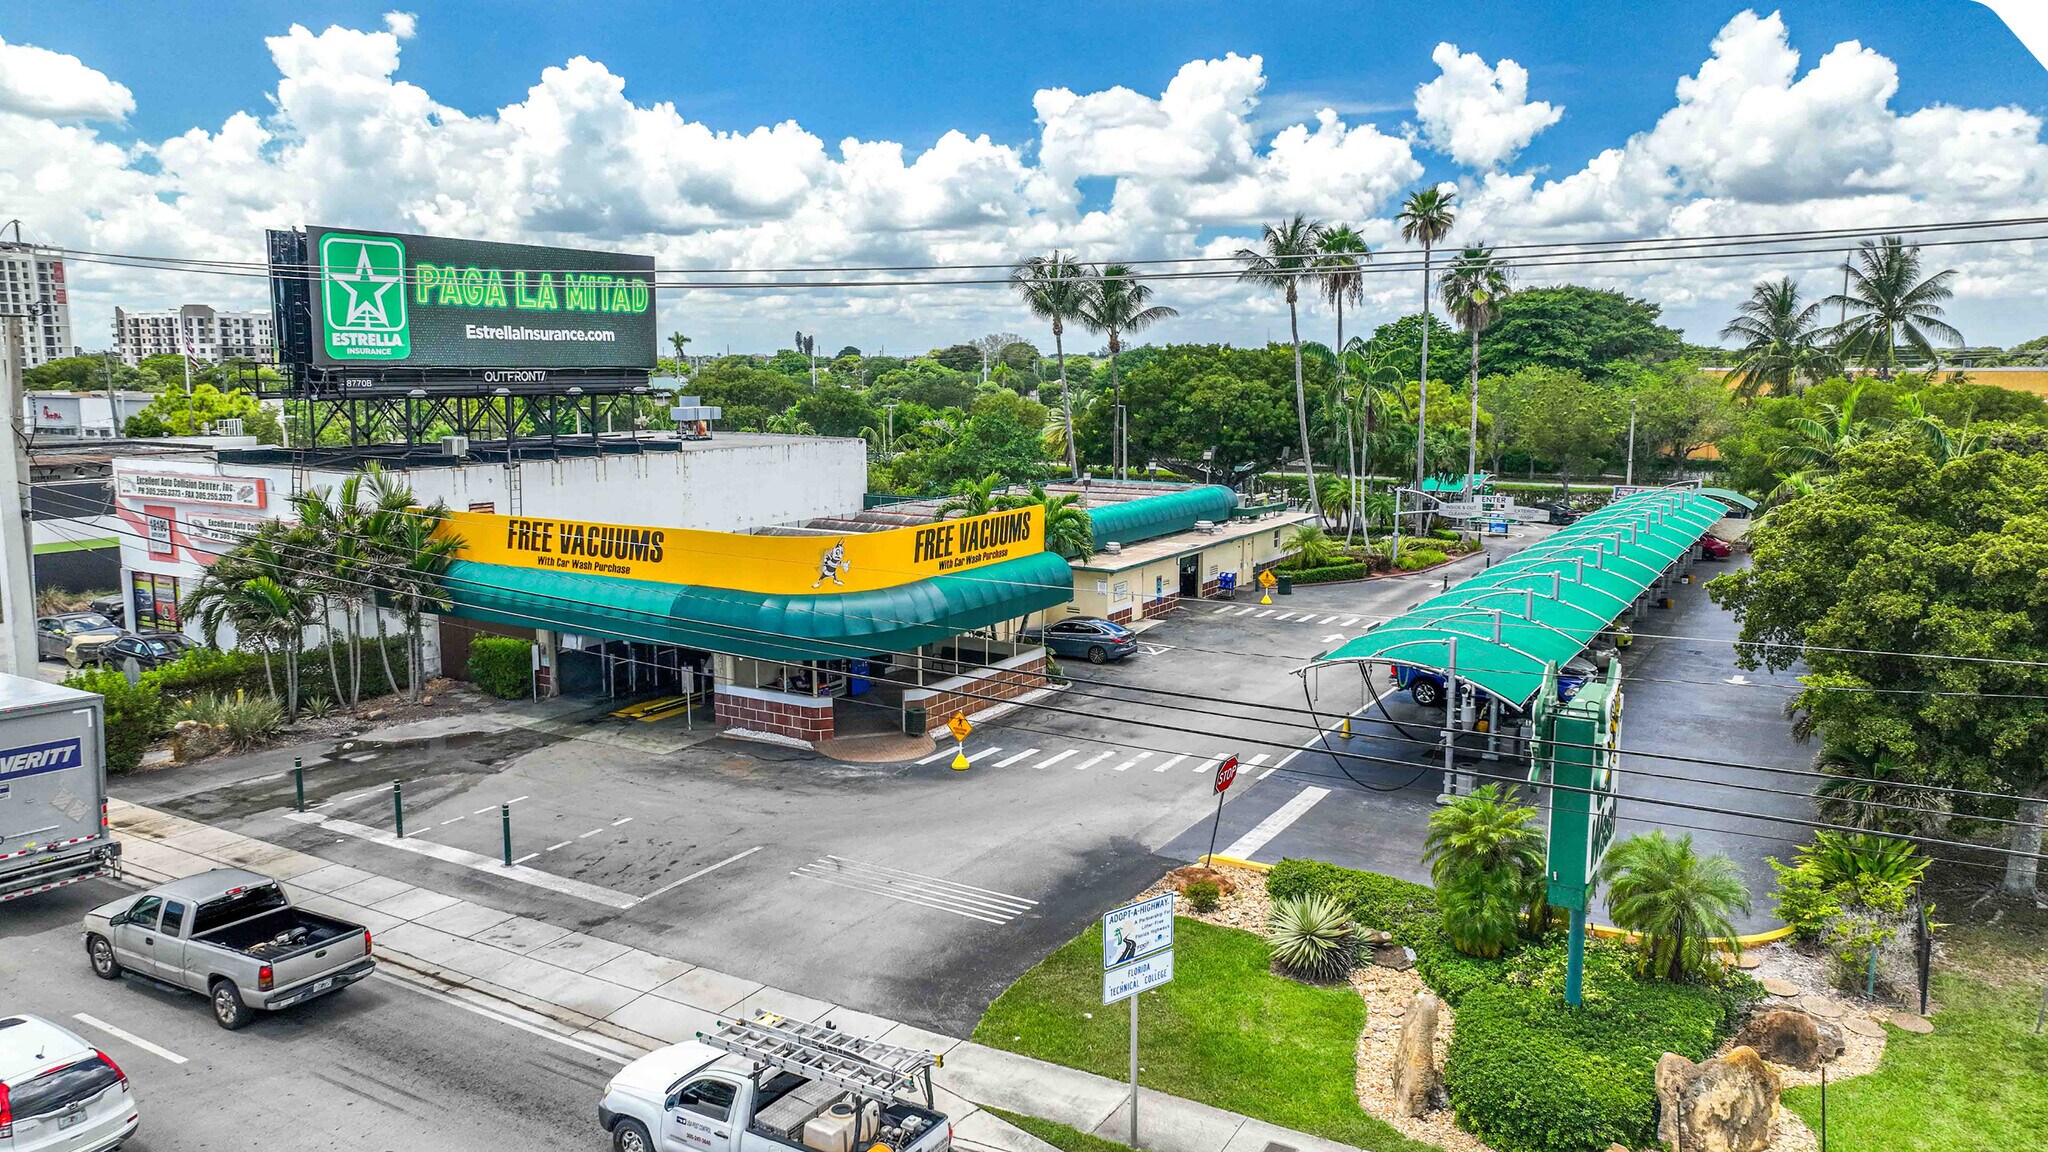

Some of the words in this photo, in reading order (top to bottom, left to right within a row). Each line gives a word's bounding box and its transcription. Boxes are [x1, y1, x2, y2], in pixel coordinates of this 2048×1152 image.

[416, 264, 507, 306] PAGA
[515, 271, 558, 309] LA
[565, 274, 649, 313] MITAD
[331, 332, 404, 347] ESTRELLA
[465, 324, 616, 342] EstrellaInsurance.com
[346, 347, 392, 355] INSURANCE
[346, 379, 373, 387] 8770B
[136, 475, 161, 485] Excellent
[161, 477, 173, 487] Auto
[173, 478, 198, 490] Collision
[137, 486, 145, 494] PH
[185, 491, 194, 499] FAX
[1481, 496, 1507, 504] ENTER
[208, 518, 234, 530] Excellent
[233, 521, 248, 531] Auto
[507, 519, 554, 553] FREE
[559, 523, 665, 564] VACUUMS
[914, 524, 955, 563] FREE
[959, 511, 1031, 554] VACUUMS
[537, 555, 555, 566] With
[556, 558, 570, 568] Car
[571, 559, 593, 571] Wash
[593, 561, 631, 574] Purchase
[938, 559, 954, 571] With
[953, 557, 966, 568] Car
[965, 553, 982, 565] Wash
[982, 548, 1009, 562] Purchase
[1217, 764, 1237, 785] STOP
[1127, 963, 1151, 978] FLORIDA
[1110, 979, 1139, 997] TECHNICAL
[1144, 968, 1167, 985] COLLEGE
